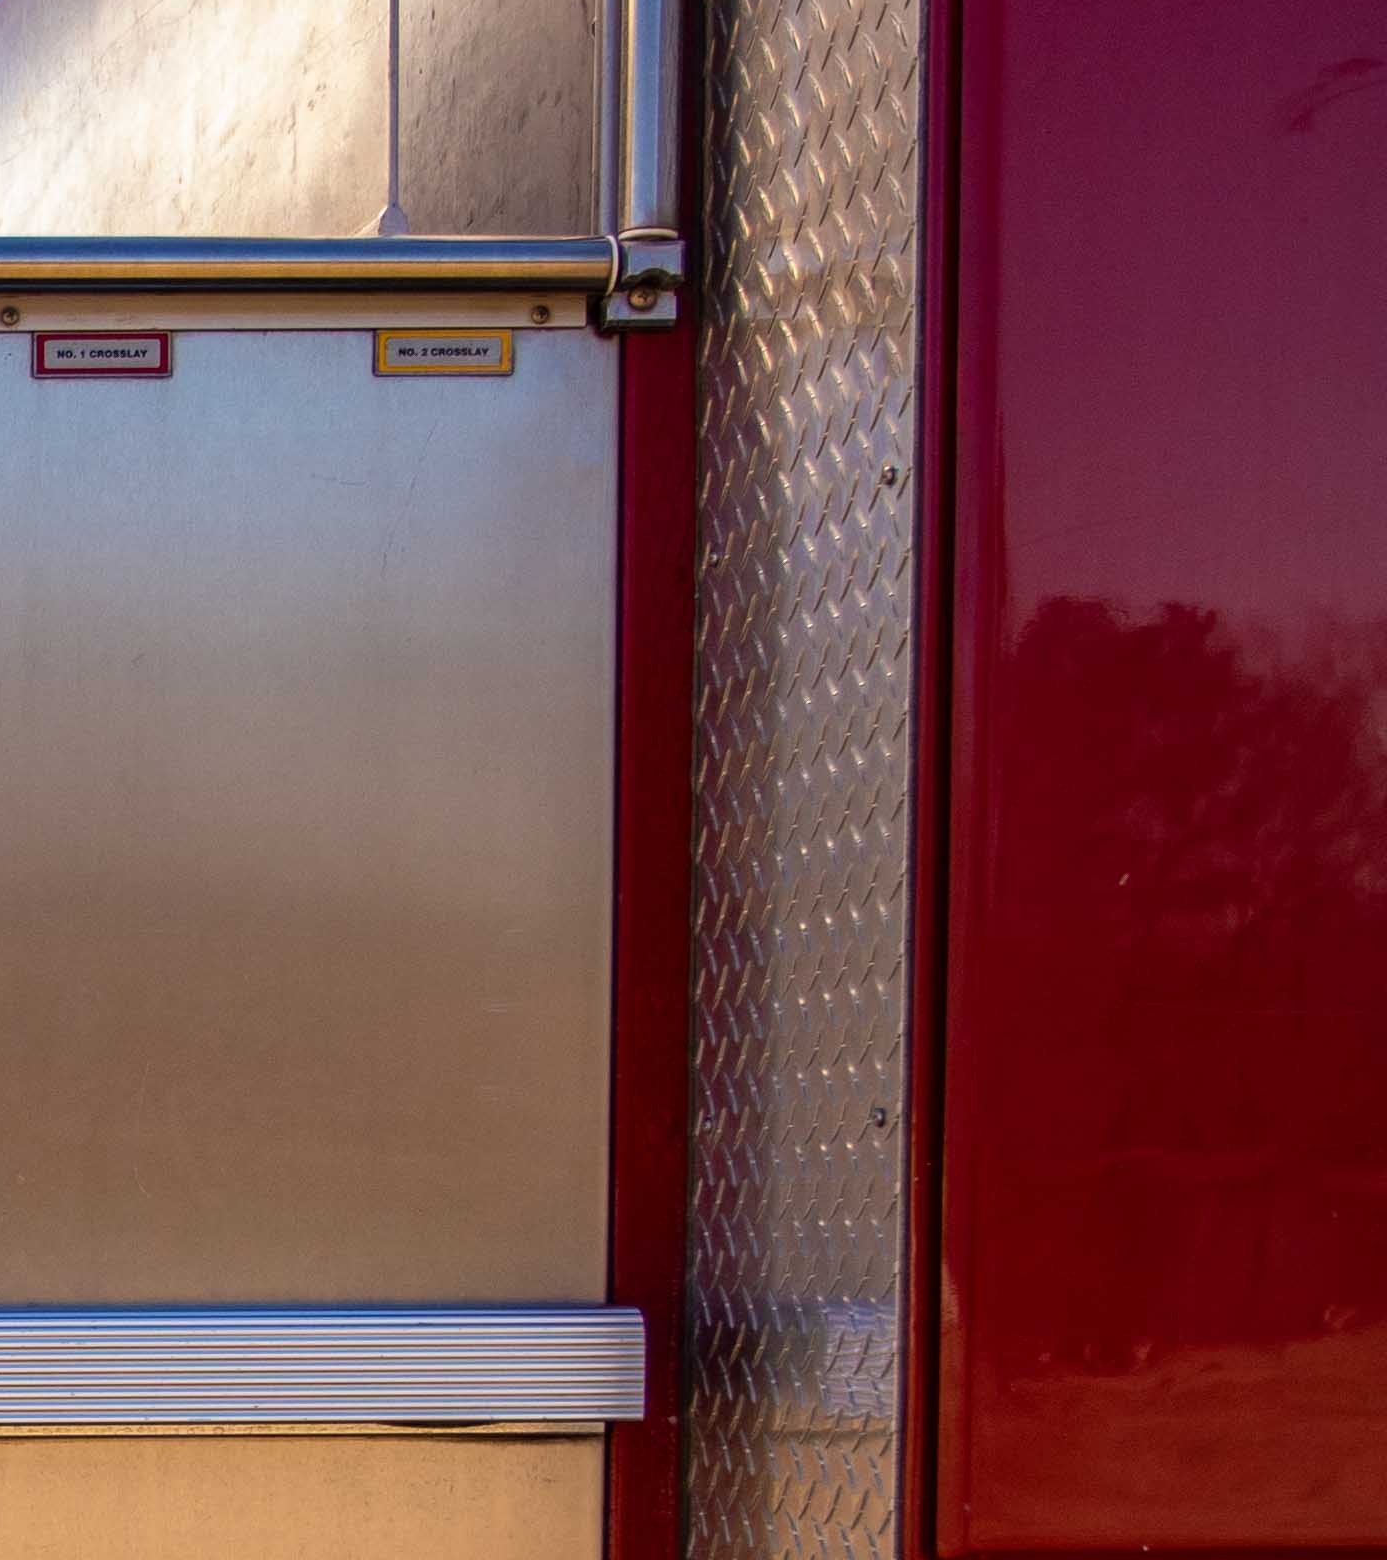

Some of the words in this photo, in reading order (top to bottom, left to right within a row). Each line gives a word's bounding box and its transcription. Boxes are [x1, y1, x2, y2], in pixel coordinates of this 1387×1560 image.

[56, 349, 77, 359] NO.
[80, 349, 85, 359] 1
[89, 349, 148, 359] CROSSLAY
[398, 347, 418, 357] NO.
[421, 347, 428, 357] 2
[430, 347, 489, 357] CROSSLAY
